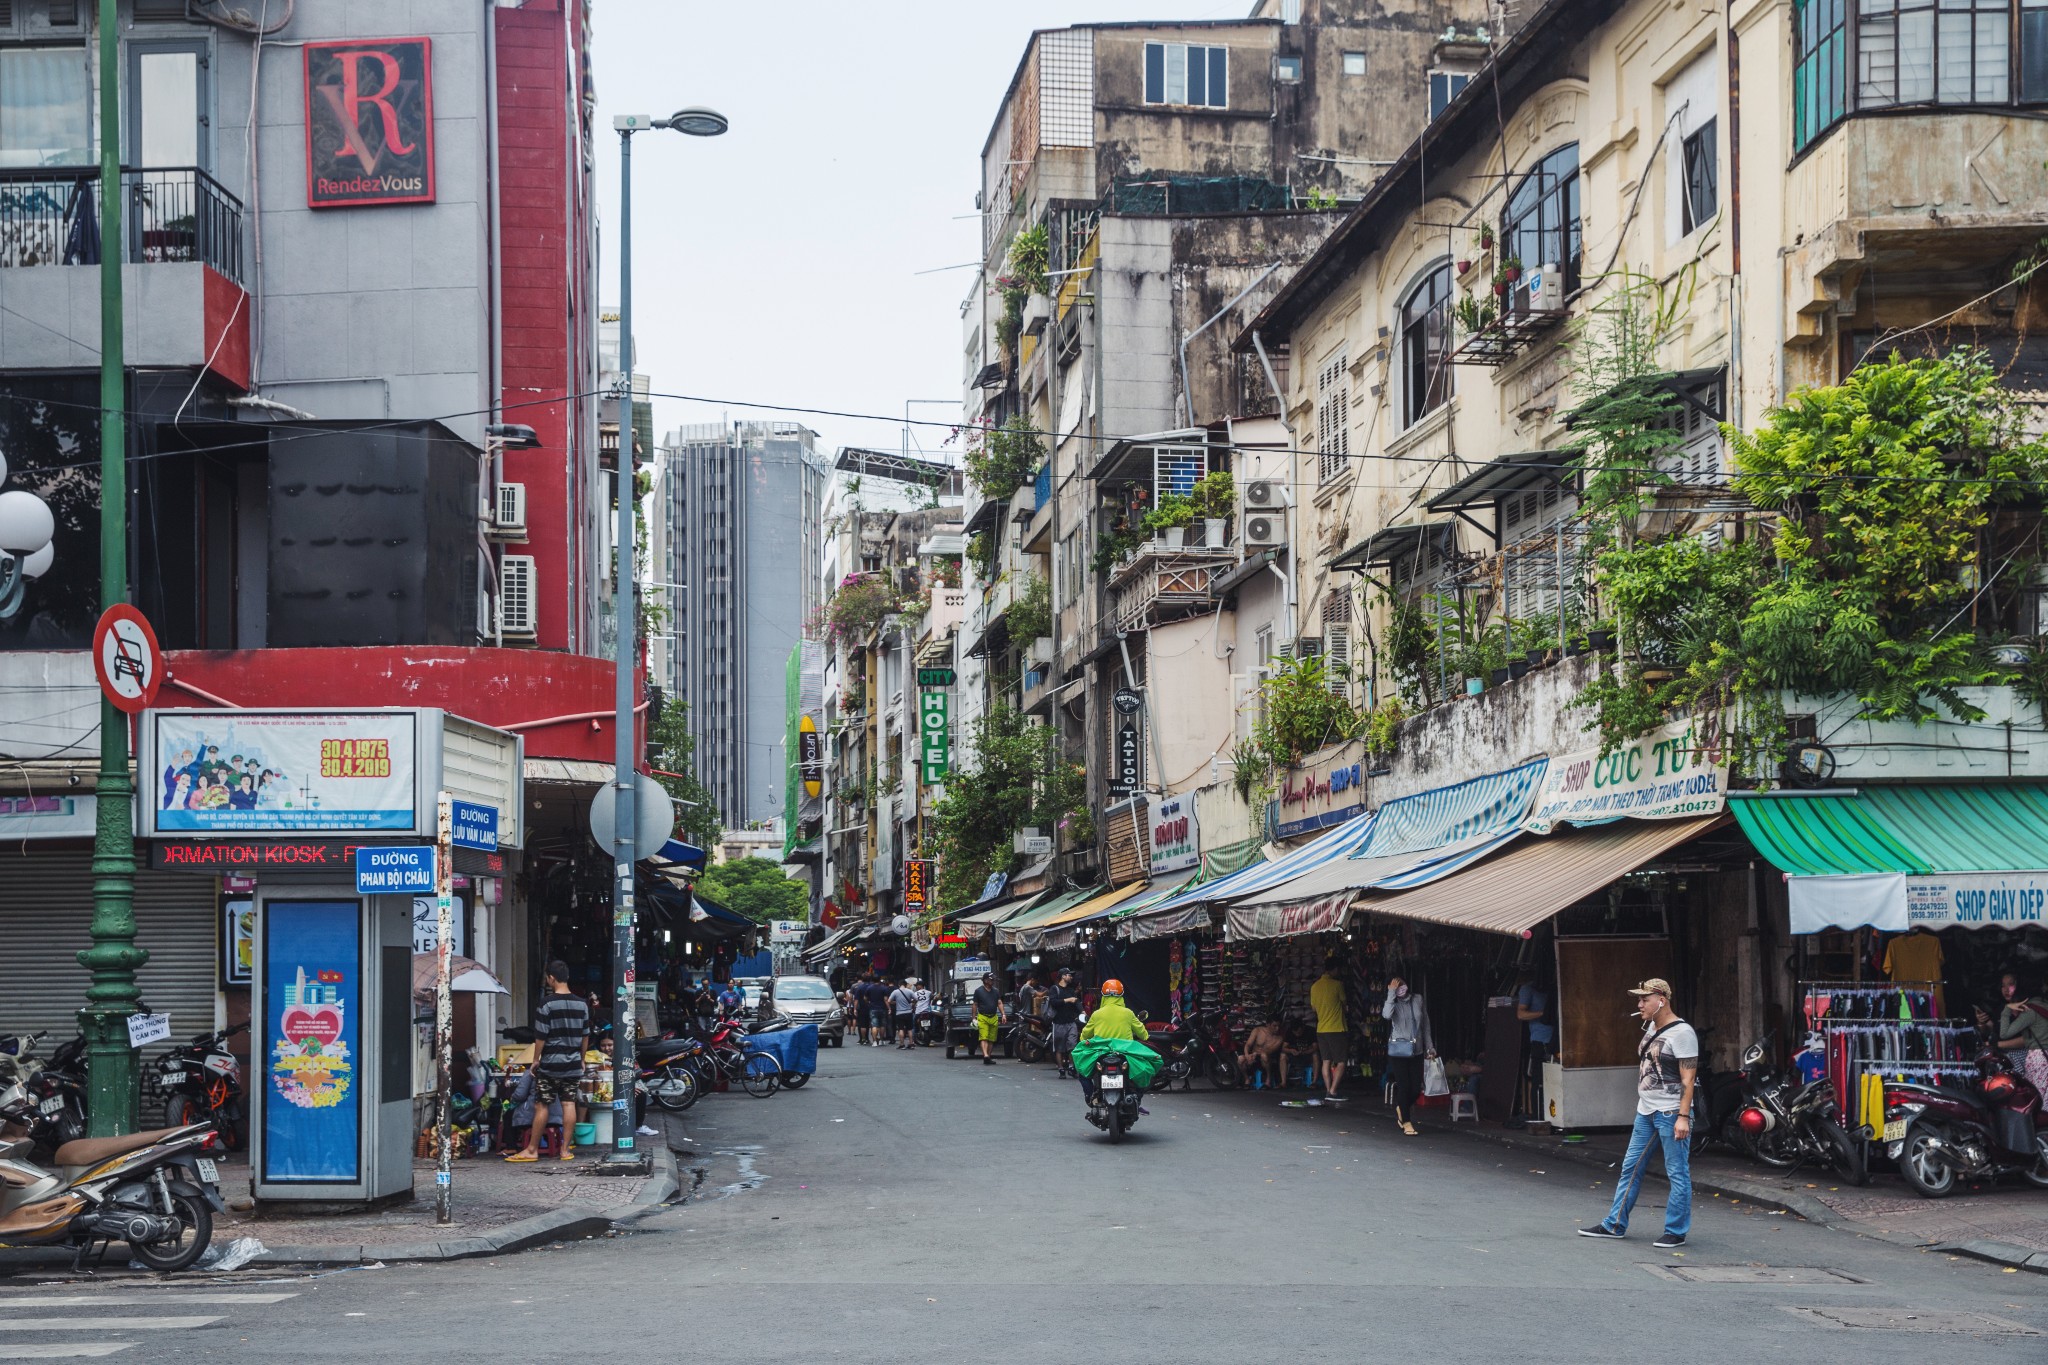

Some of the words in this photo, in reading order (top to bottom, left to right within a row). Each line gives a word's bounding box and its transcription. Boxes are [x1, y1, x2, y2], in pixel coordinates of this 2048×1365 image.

[317, 175, 423, 195] RendezVous
[919, 670, 952, 685] CITY
[924, 694, 944, 782] HOTEL
[322, 740, 387, 758] 30.4.1975
[1123, 731, 1136, 784] TATTOO
[322, 759, 389, 777] 30.4.2019
[1560, 759, 1591, 794] SHOP
[1610, 791, 1635, 809] THEO
[1657, 776, 1684, 803] TRANG
[1683, 772, 1718, 797] MODEL
[461, 808, 489, 824] ĐƯỜNG
[453, 825, 465, 841] LƯU
[466, 825, 478, 842] VĂN
[480, 831, 496, 845] LANG
[265, 846, 326, 863] KIOSK
[371, 851, 419, 866] ĐƯỜNG
[360, 872, 385, 887] PHAN
[387, 868, 403, 890] BỘI
[404, 868, 430, 885] CHÂU
[907, 892, 925, 902] SPA
[1955, 889, 1986, 921] SHOP
[1988, 880, 2016, 921] GIÀY
[2019, 880, 2044, 920] DÉP
[1911, 911, 1948, 919] 0938.391317
